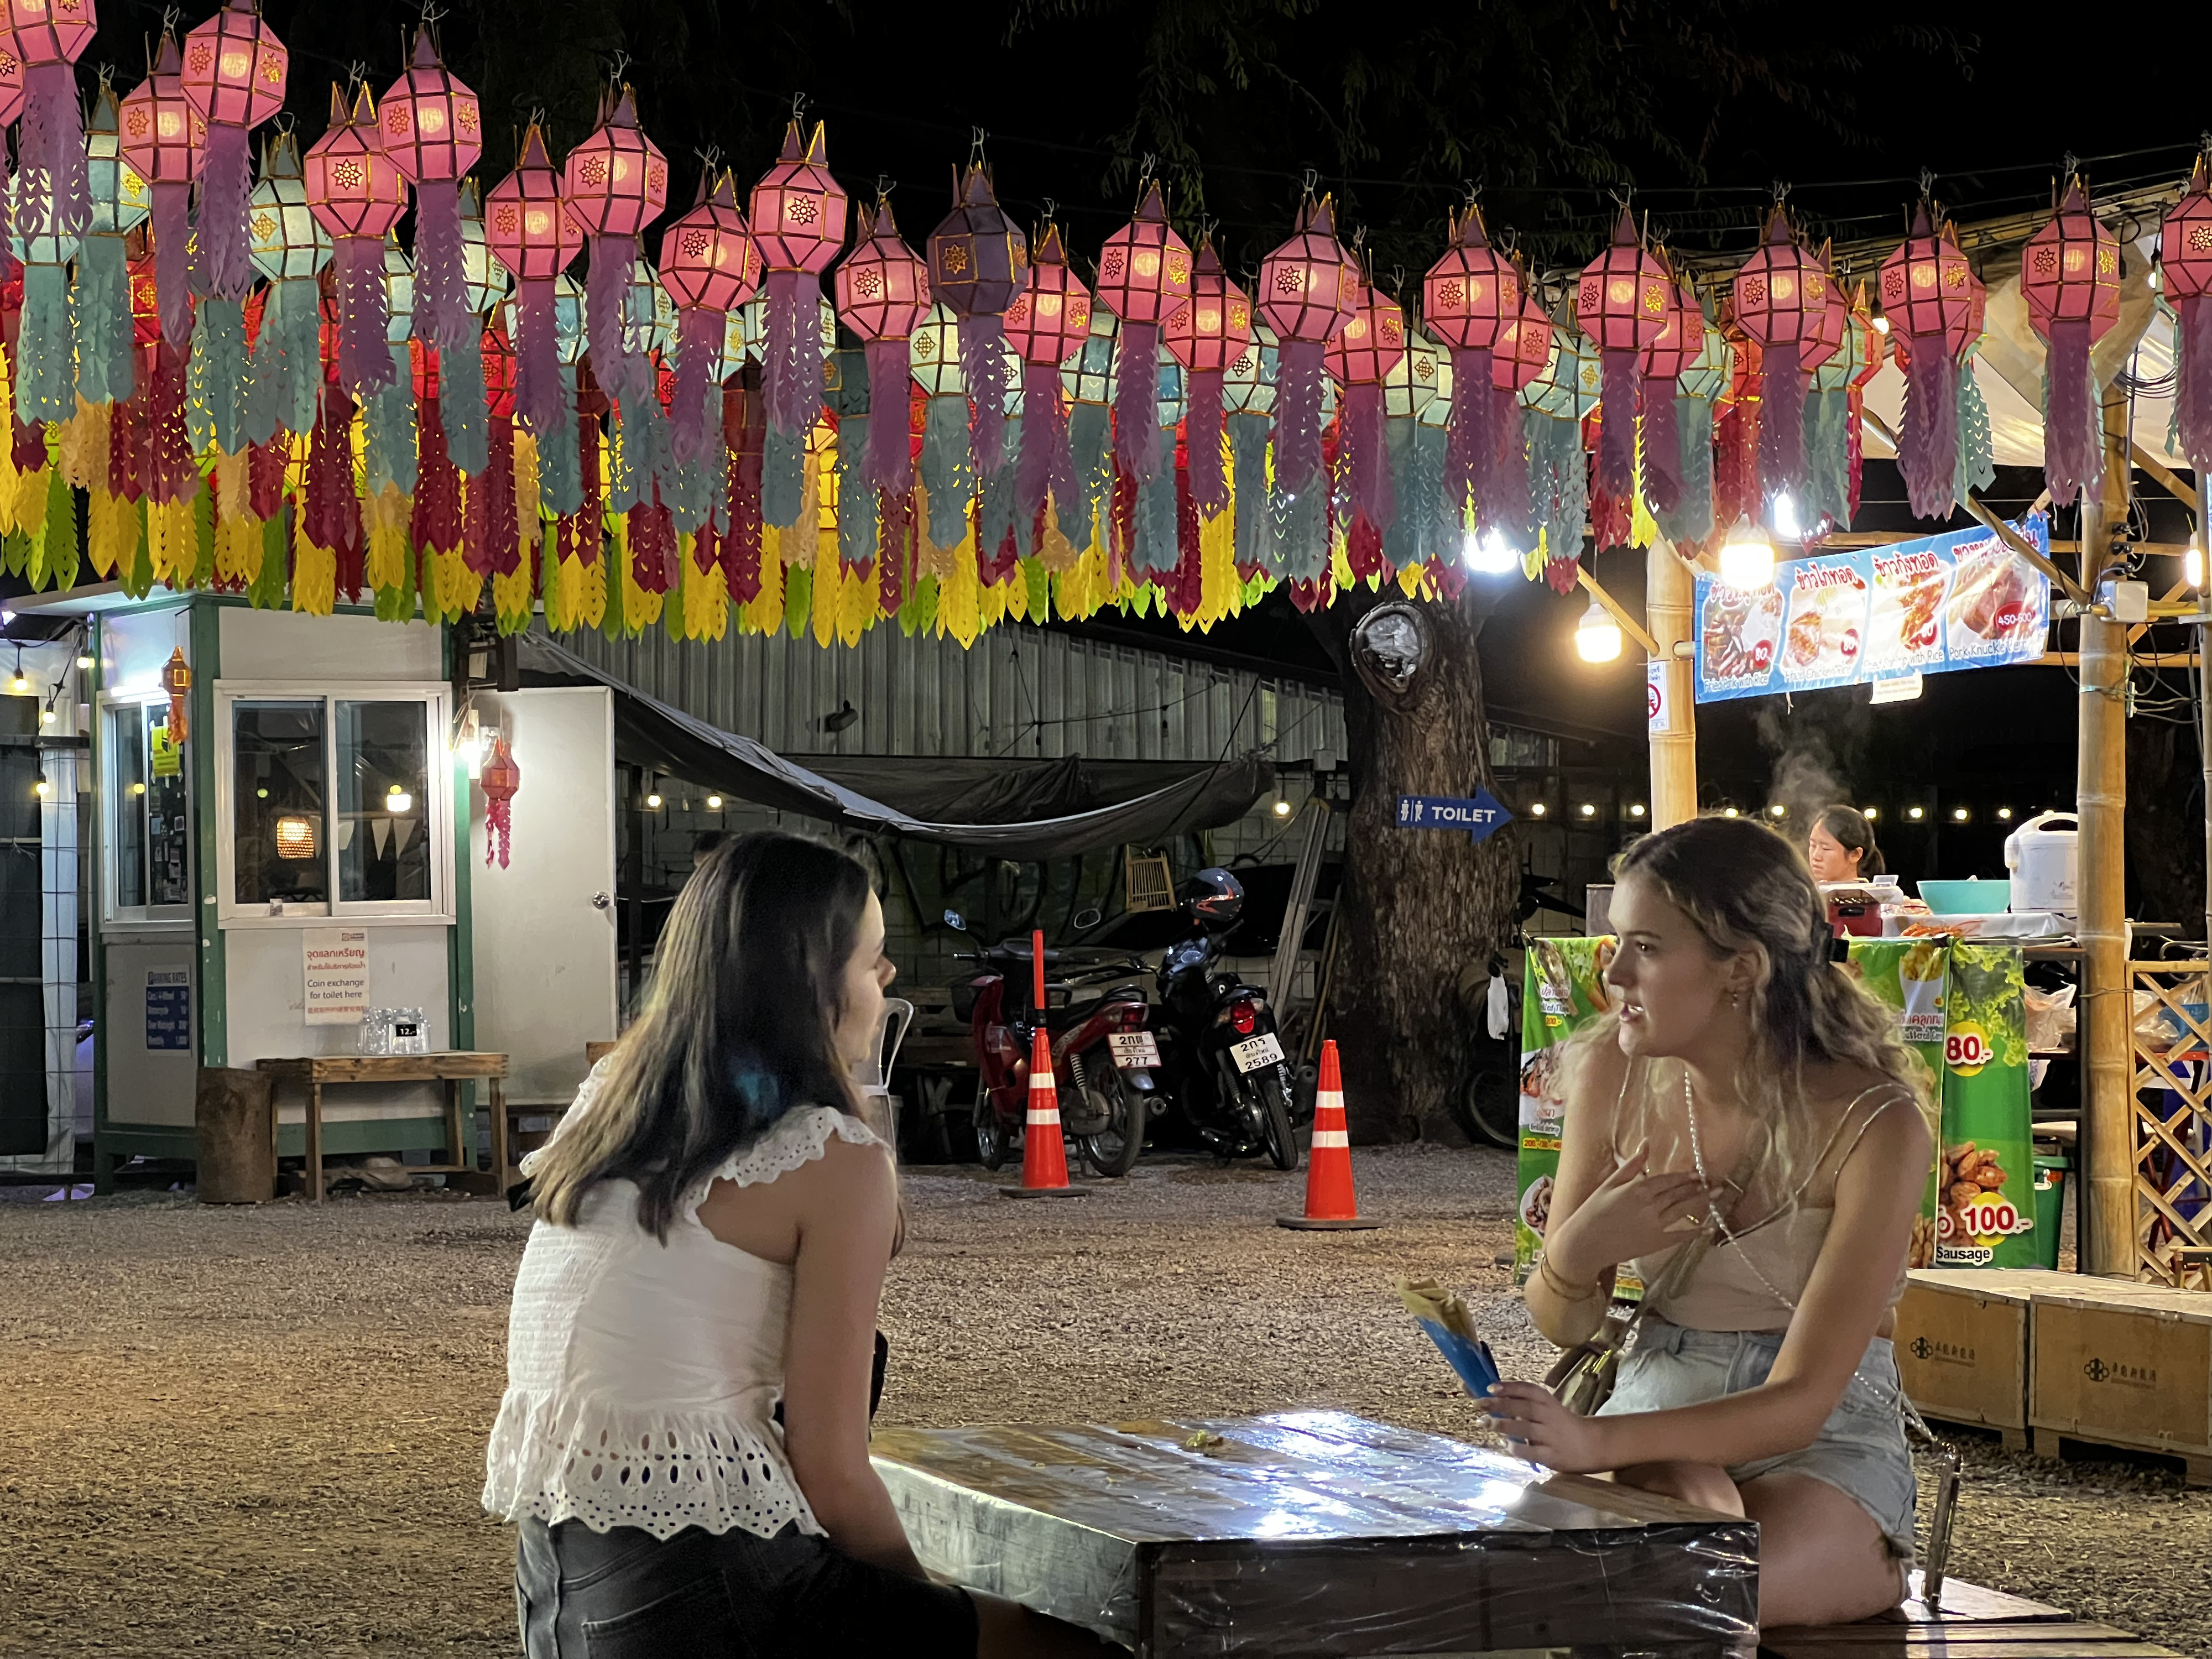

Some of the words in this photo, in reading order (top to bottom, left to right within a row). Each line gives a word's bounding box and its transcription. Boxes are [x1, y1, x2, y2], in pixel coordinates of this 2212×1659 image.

[1874, 553, 1939, 580] ข้าวกุ้งทอด
[1796, 564, 1856, 590] ข้าวไก่ทอด
[1998, 612, 2032, 625] 450-600
[1755, 648, 1768, 660] 80
[1910, 651, 1925, 664] with
[1927, 649, 1943, 661] Rice
[1949, 646, 1968, 658] Pork
[1739, 675, 1753, 686] with
[1754, 673, 1768, 684] Rice
[1431, 806, 1496, 823] TOILET
[307, 947, 365, 961] จุดแลกเหรียญ
[307, 979, 325, 988] Coin
[327, 979, 364, 988] exchange
[310, 991, 321, 999] for
[345, 990, 362, 998] here
[1125, 1056, 1148, 1066] 277
[1245, 1053, 1277, 1070] 2589
[1964, 1206, 2030, 1232] 100.-
[1936, 1246, 1990, 1262] Sausage
